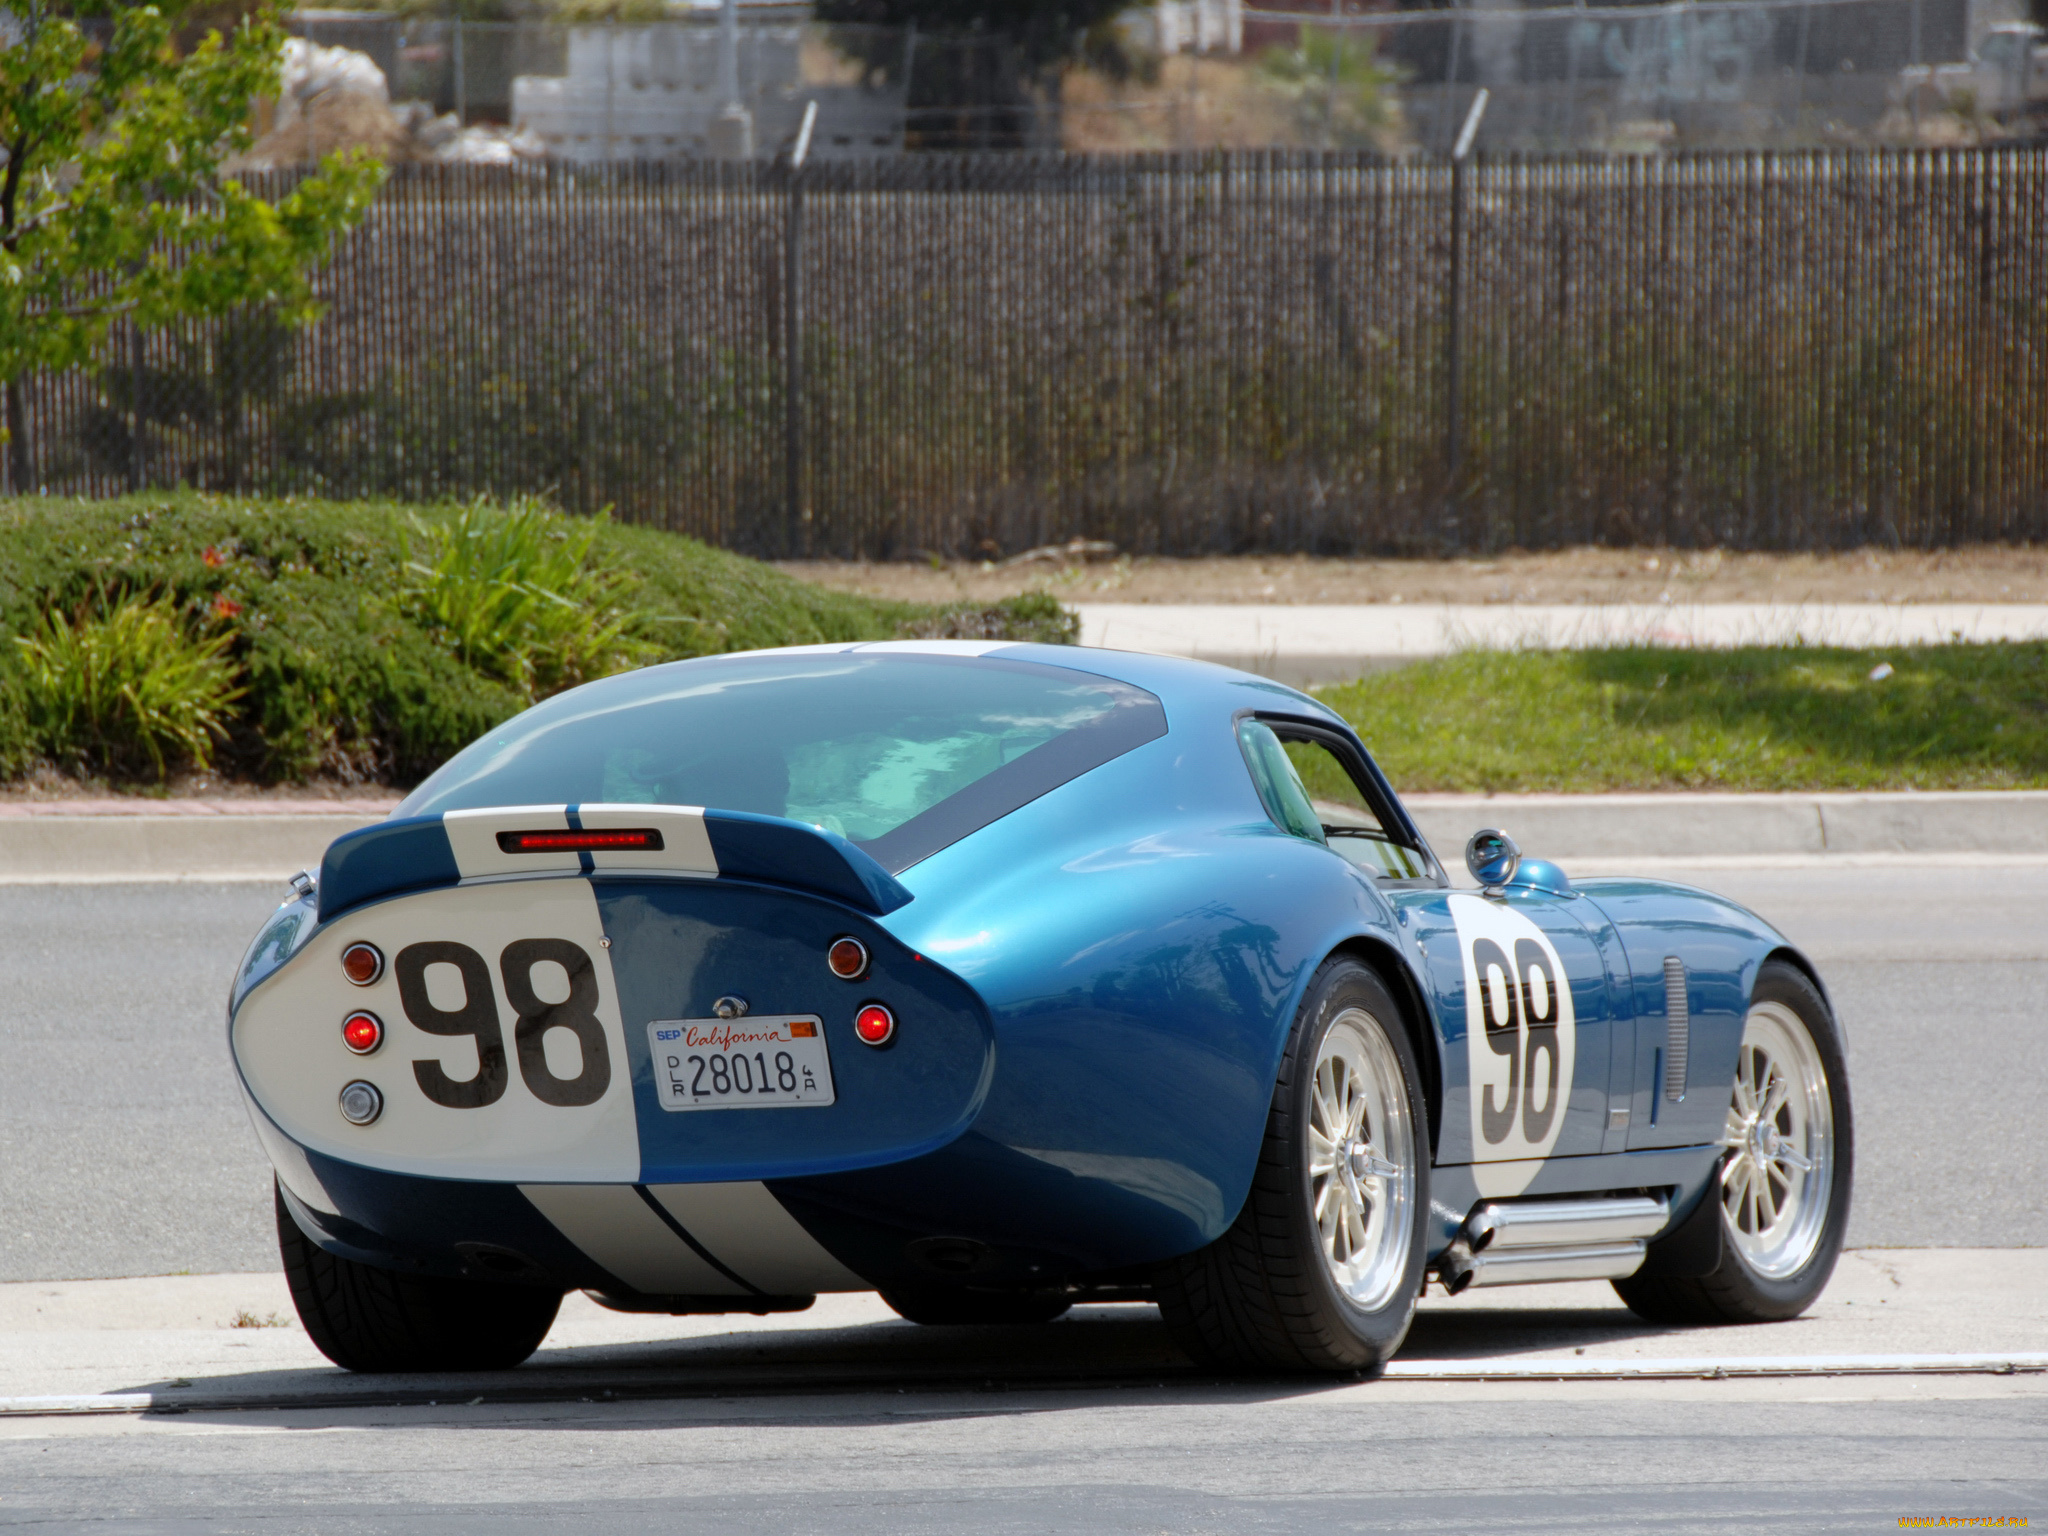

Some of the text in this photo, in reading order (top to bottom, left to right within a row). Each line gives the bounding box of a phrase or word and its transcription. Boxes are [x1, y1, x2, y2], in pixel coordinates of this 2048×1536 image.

[395, 938, 611, 1109] 98
[656, 1030, 681, 1041] SEP
[686, 1026, 792, 1051] California
[688, 1051, 796, 1096] 28018
[1473, 938, 1560, 1144] 98
